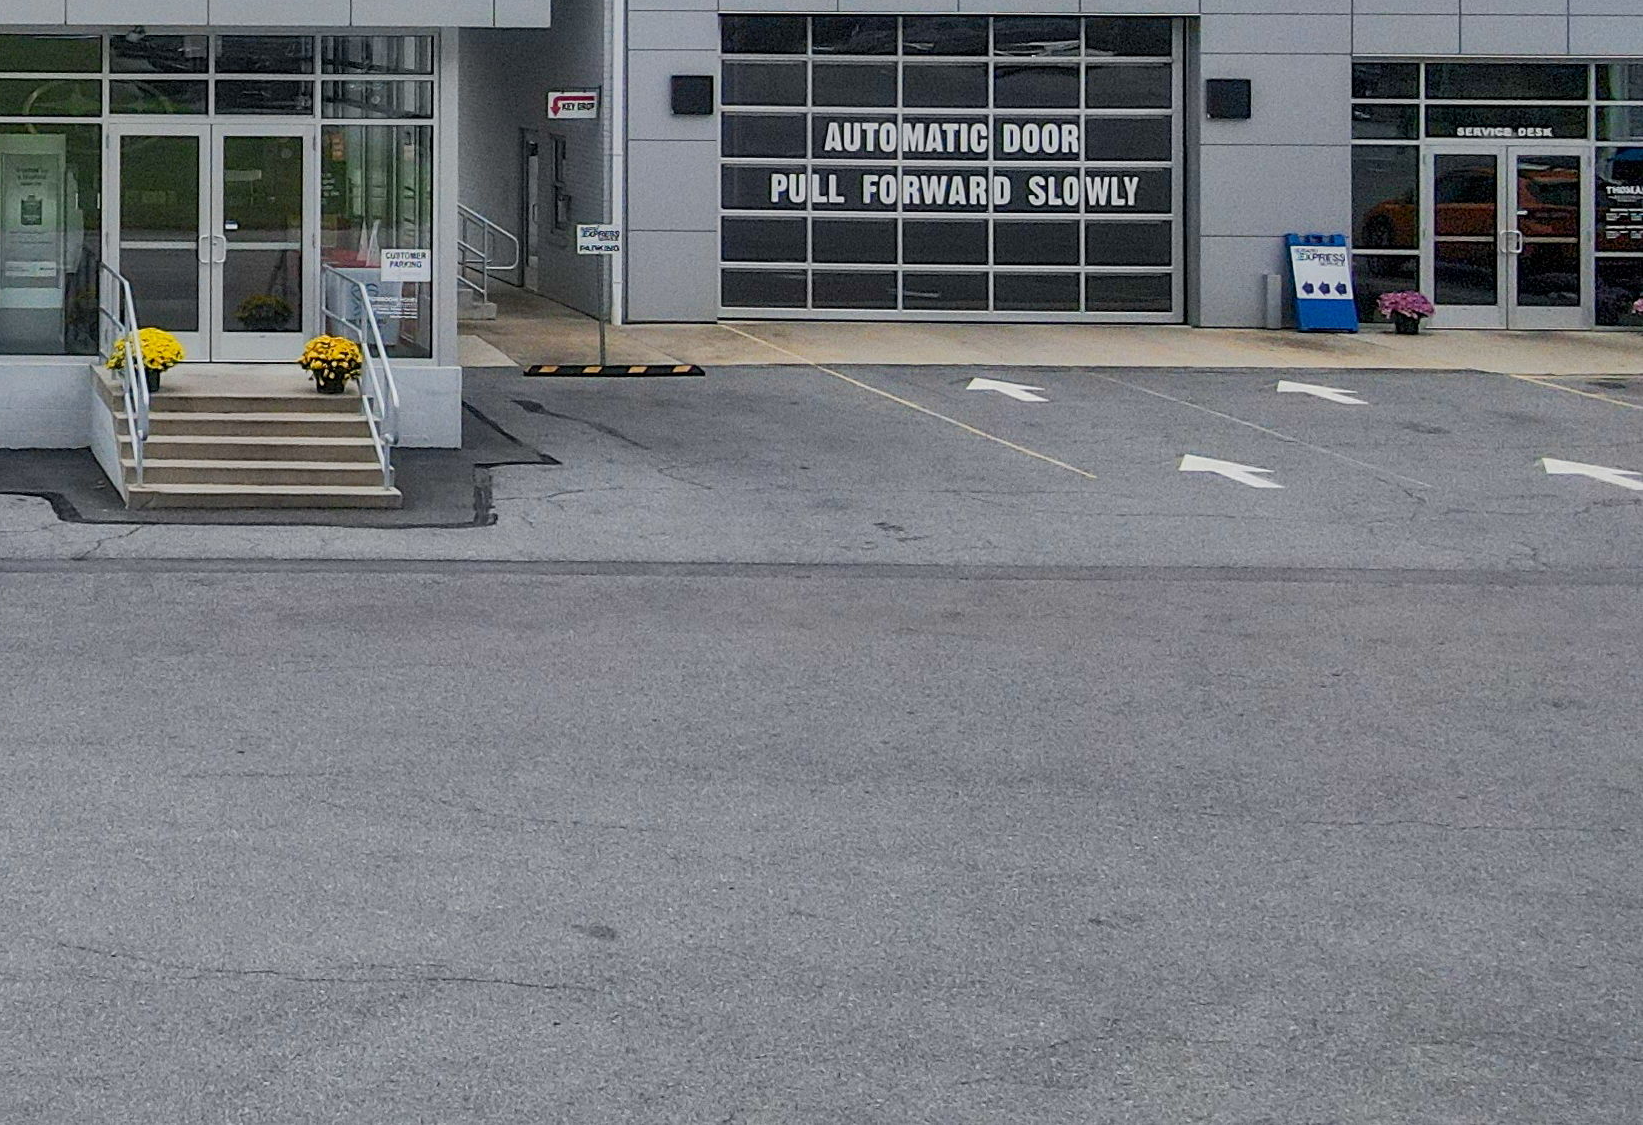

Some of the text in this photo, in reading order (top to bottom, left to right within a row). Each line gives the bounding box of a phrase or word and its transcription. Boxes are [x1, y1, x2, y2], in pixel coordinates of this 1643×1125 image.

[1456, 127, 1554, 137] SERVICE DESK
[824, 122, 1080, 154] AUTOMATIC DOOR
[769, 174, 1140, 207] PULL FORWARD SLOWLY
[385, 252, 427, 260] CUSTOMER
[389, 260, 423, 269] PARKING
